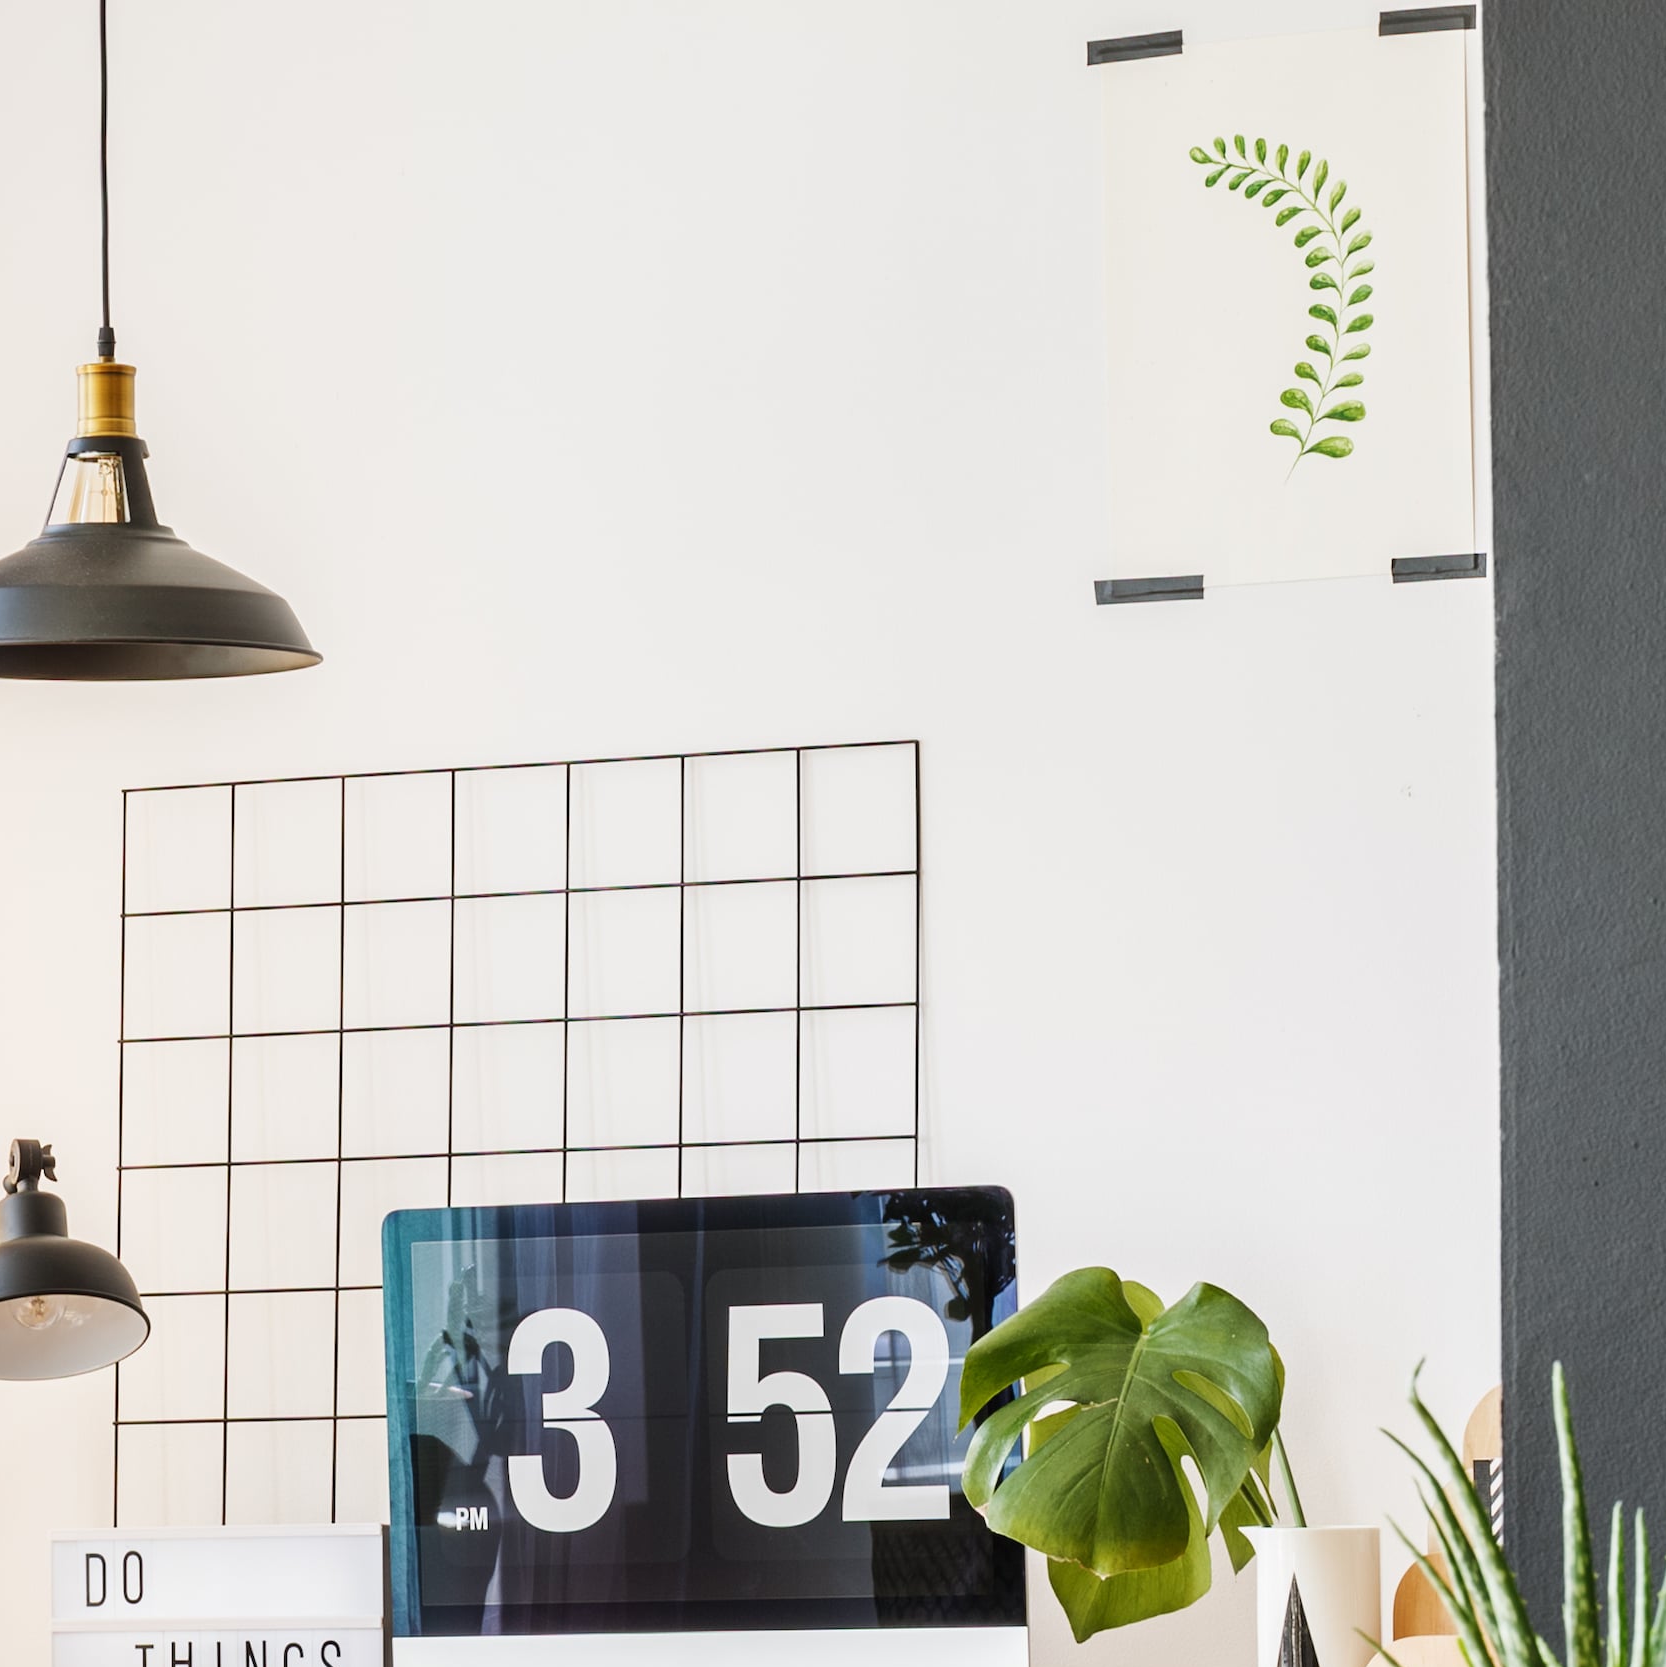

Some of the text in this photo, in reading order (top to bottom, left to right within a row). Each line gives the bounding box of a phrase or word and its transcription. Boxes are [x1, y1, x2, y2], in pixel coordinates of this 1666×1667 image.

[506, 1296, 951, 1533] 3 52
[455, 1506, 489, 1531] PM
[85, 1550, 144, 1607] DO
